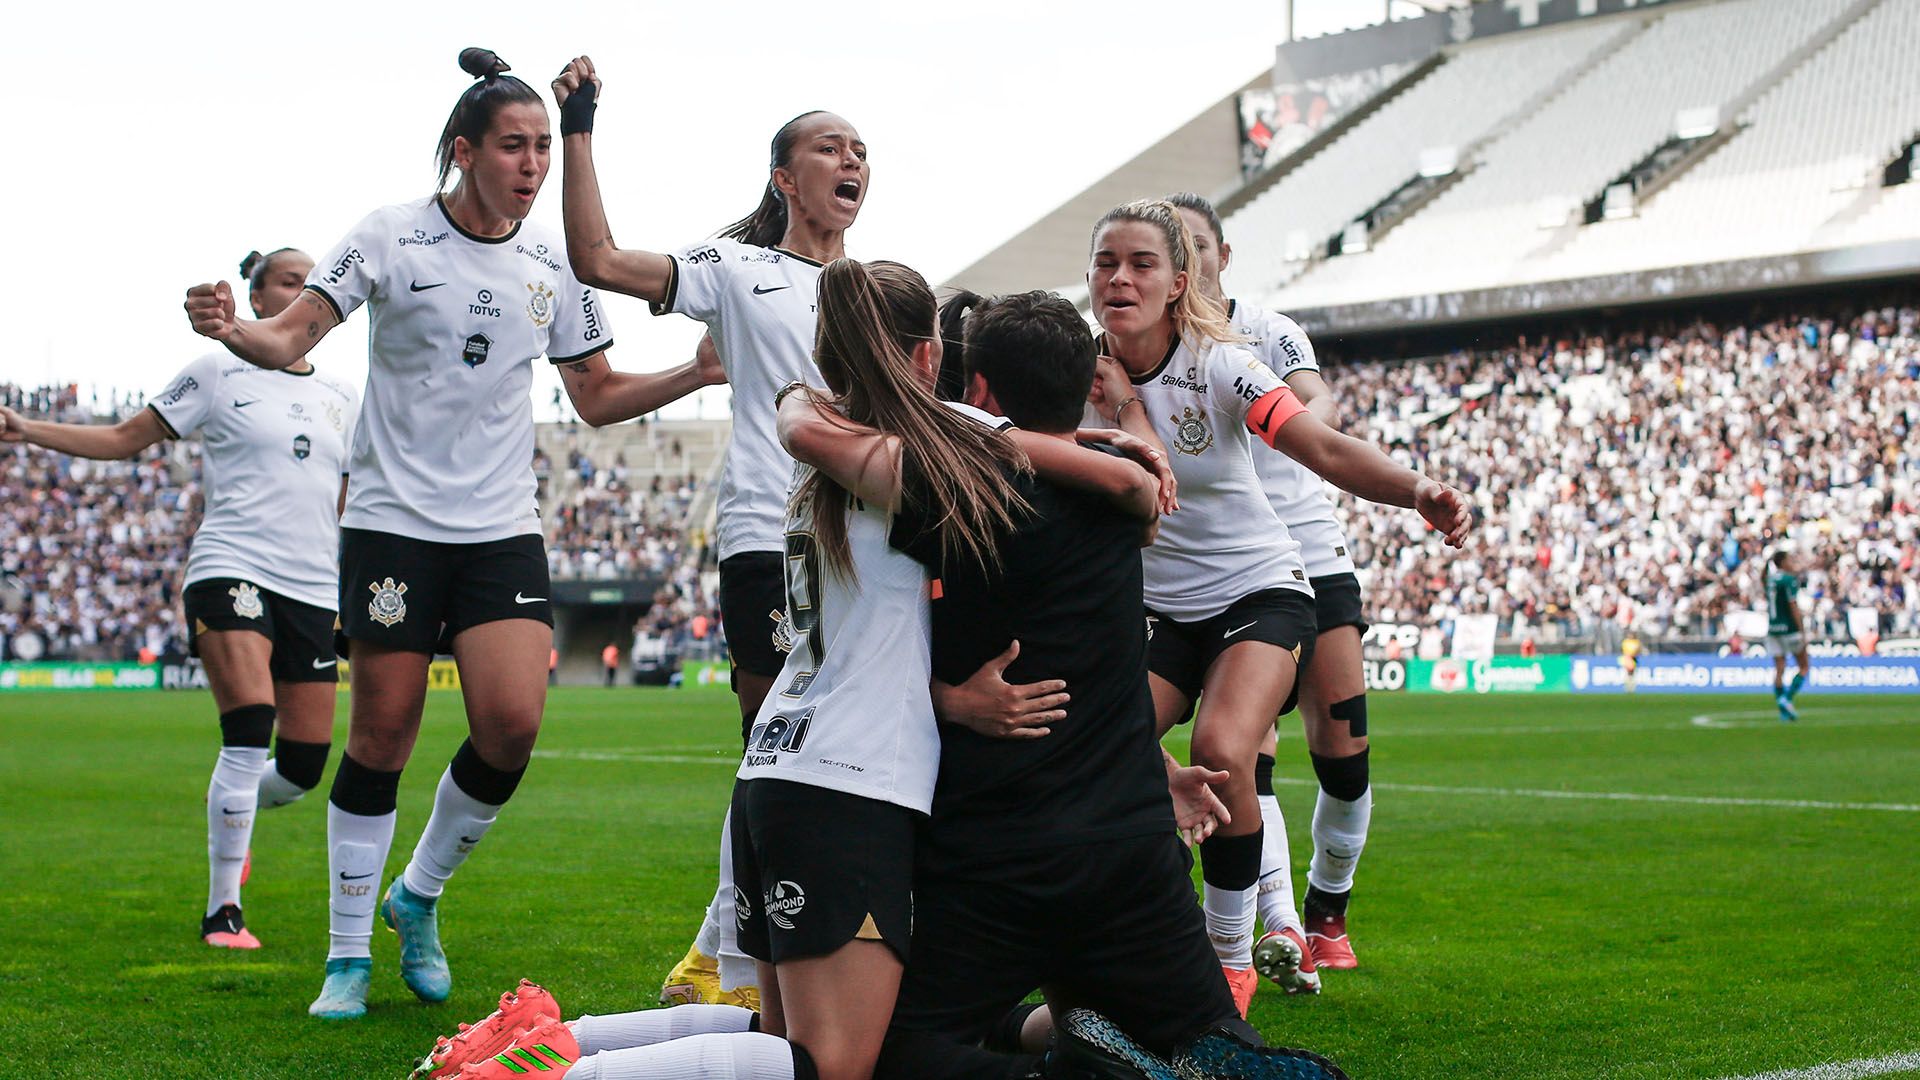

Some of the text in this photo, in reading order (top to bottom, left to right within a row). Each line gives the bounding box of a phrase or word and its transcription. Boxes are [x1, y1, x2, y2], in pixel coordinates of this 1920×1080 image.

[331, 249, 365, 278] bmg
[468, 304, 501, 317] TOTVS
[583, 300, 600, 341] bmg
[340, 884, 370, 896] SCCP
